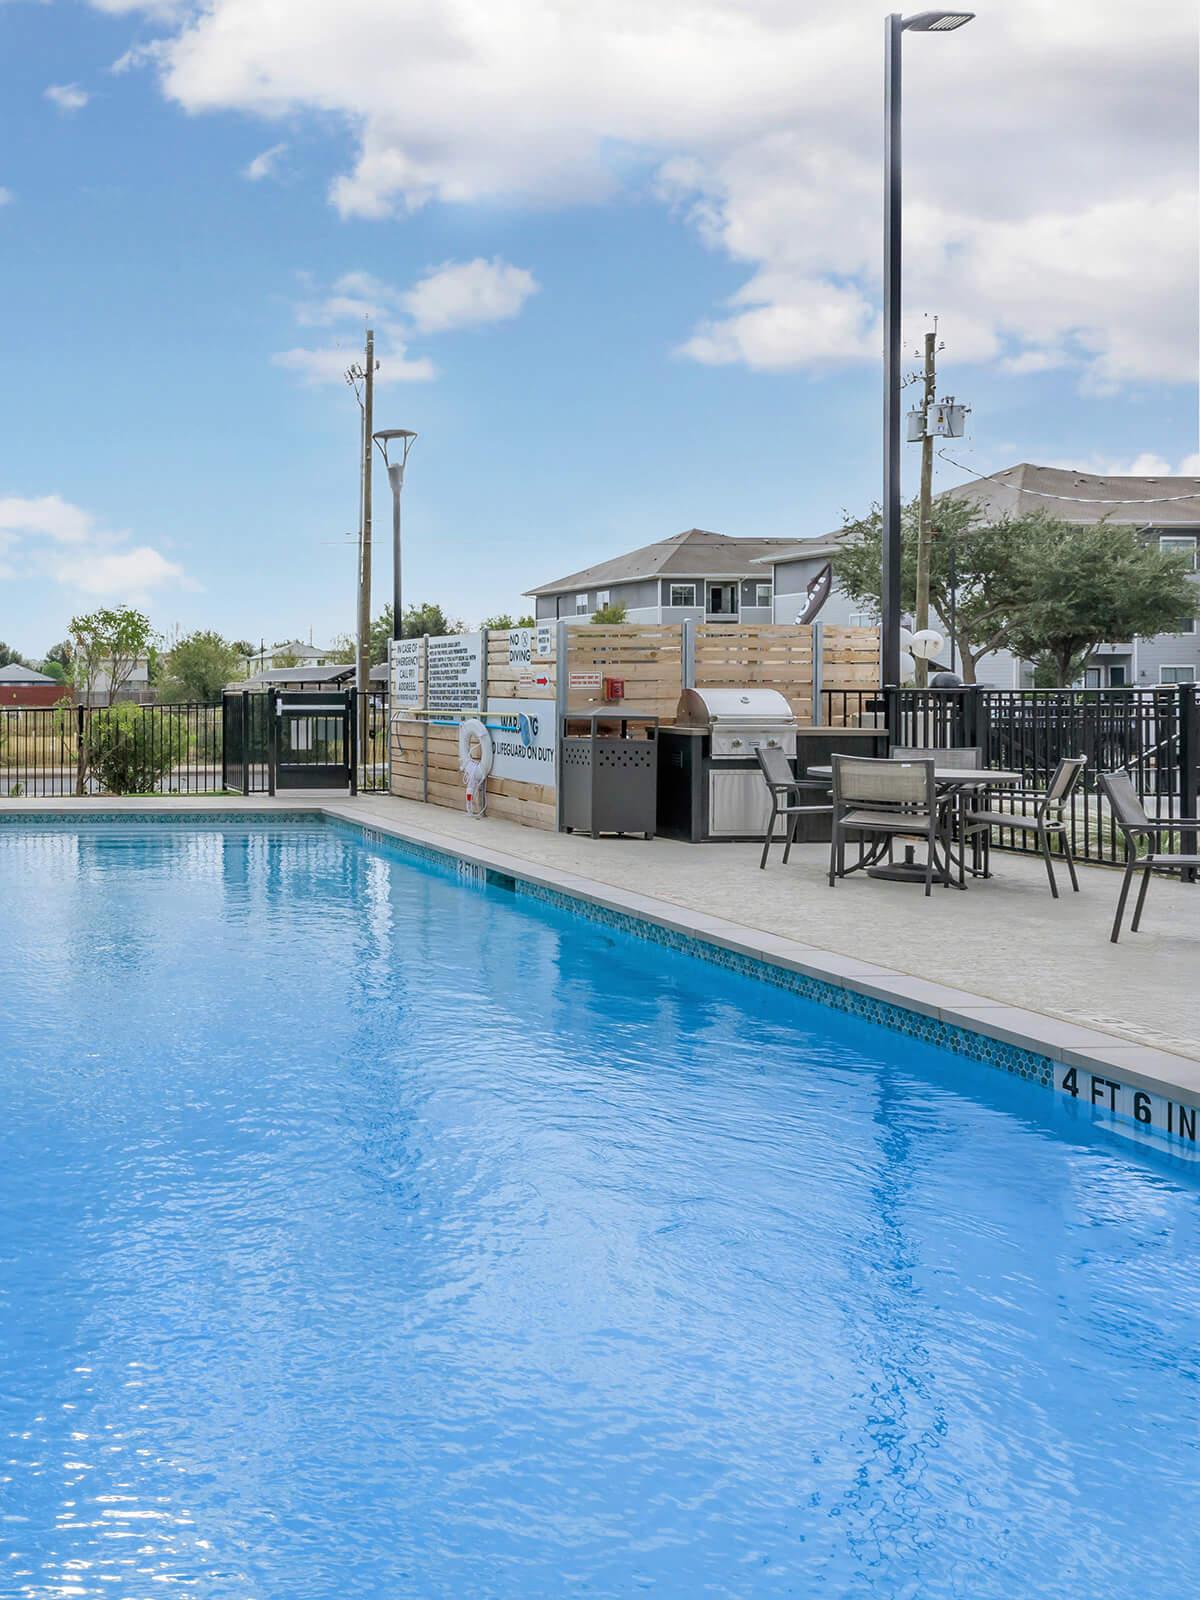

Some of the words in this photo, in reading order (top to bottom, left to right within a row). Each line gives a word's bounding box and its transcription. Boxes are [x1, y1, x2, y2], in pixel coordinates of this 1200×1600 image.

[509, 634, 520, 646] NO
[509, 649, 531, 662] DIVING
[496, 742, 526, 759] LIFEGUARD
[527, 746, 537, 760] ON
[538, 748, 555, 762] DUTY
[1062, 1067, 1079, 1097] 4
[1091, 1075, 1121, 1112] FT
[1134, 1092, 1152, 1124] 6
[1168, 1101, 1196, 1142] IN
